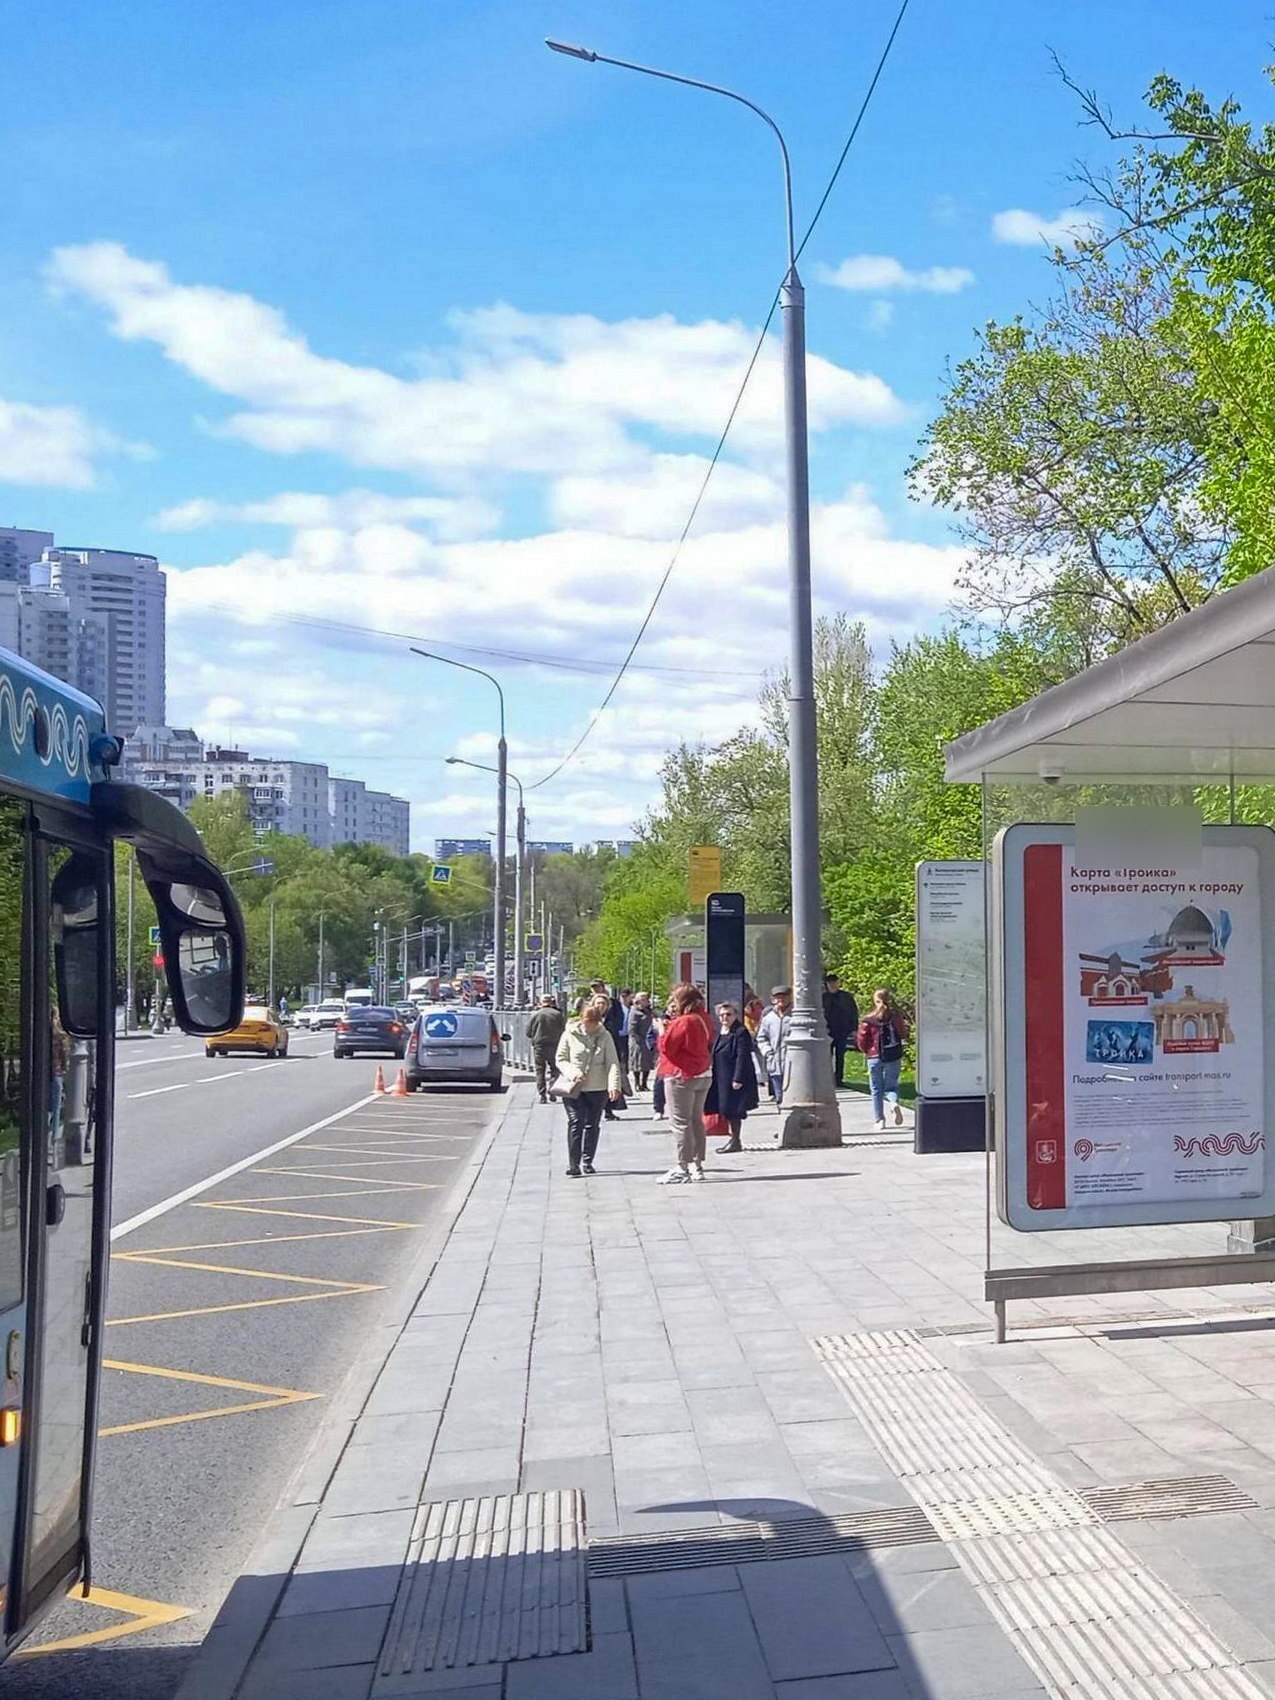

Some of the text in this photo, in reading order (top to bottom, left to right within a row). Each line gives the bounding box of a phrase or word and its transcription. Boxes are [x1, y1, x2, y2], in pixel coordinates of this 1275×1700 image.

[1071, 866, 1111, 880] Карта
[1071, 883, 1243, 895] открывает доступ к городу
[1139, 1073, 1163, 1083] сайте
